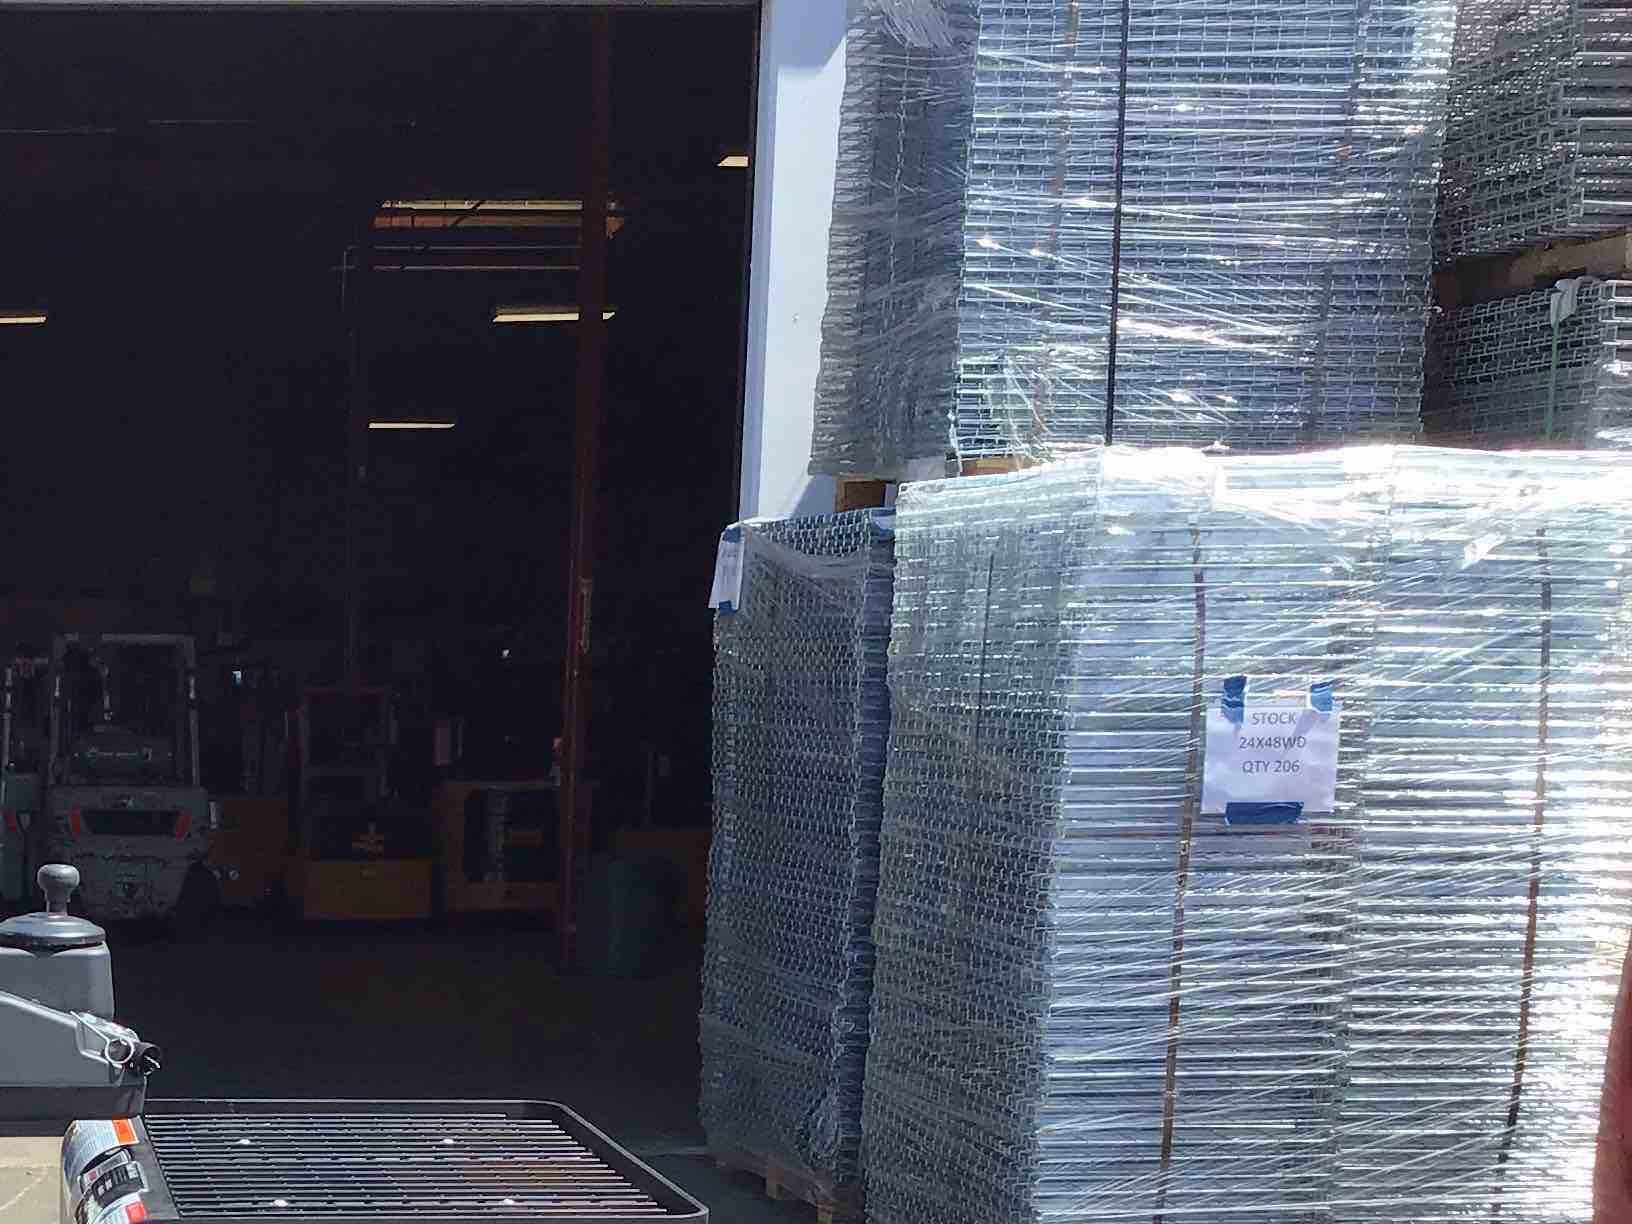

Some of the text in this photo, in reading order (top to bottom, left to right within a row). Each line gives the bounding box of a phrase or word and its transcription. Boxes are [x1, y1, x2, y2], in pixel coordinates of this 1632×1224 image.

[1252, 712, 1296, 724] STOCK
[1239, 735, 1306, 749] 24X48WD
[1242, 760, 1300, 774] QTY 206
